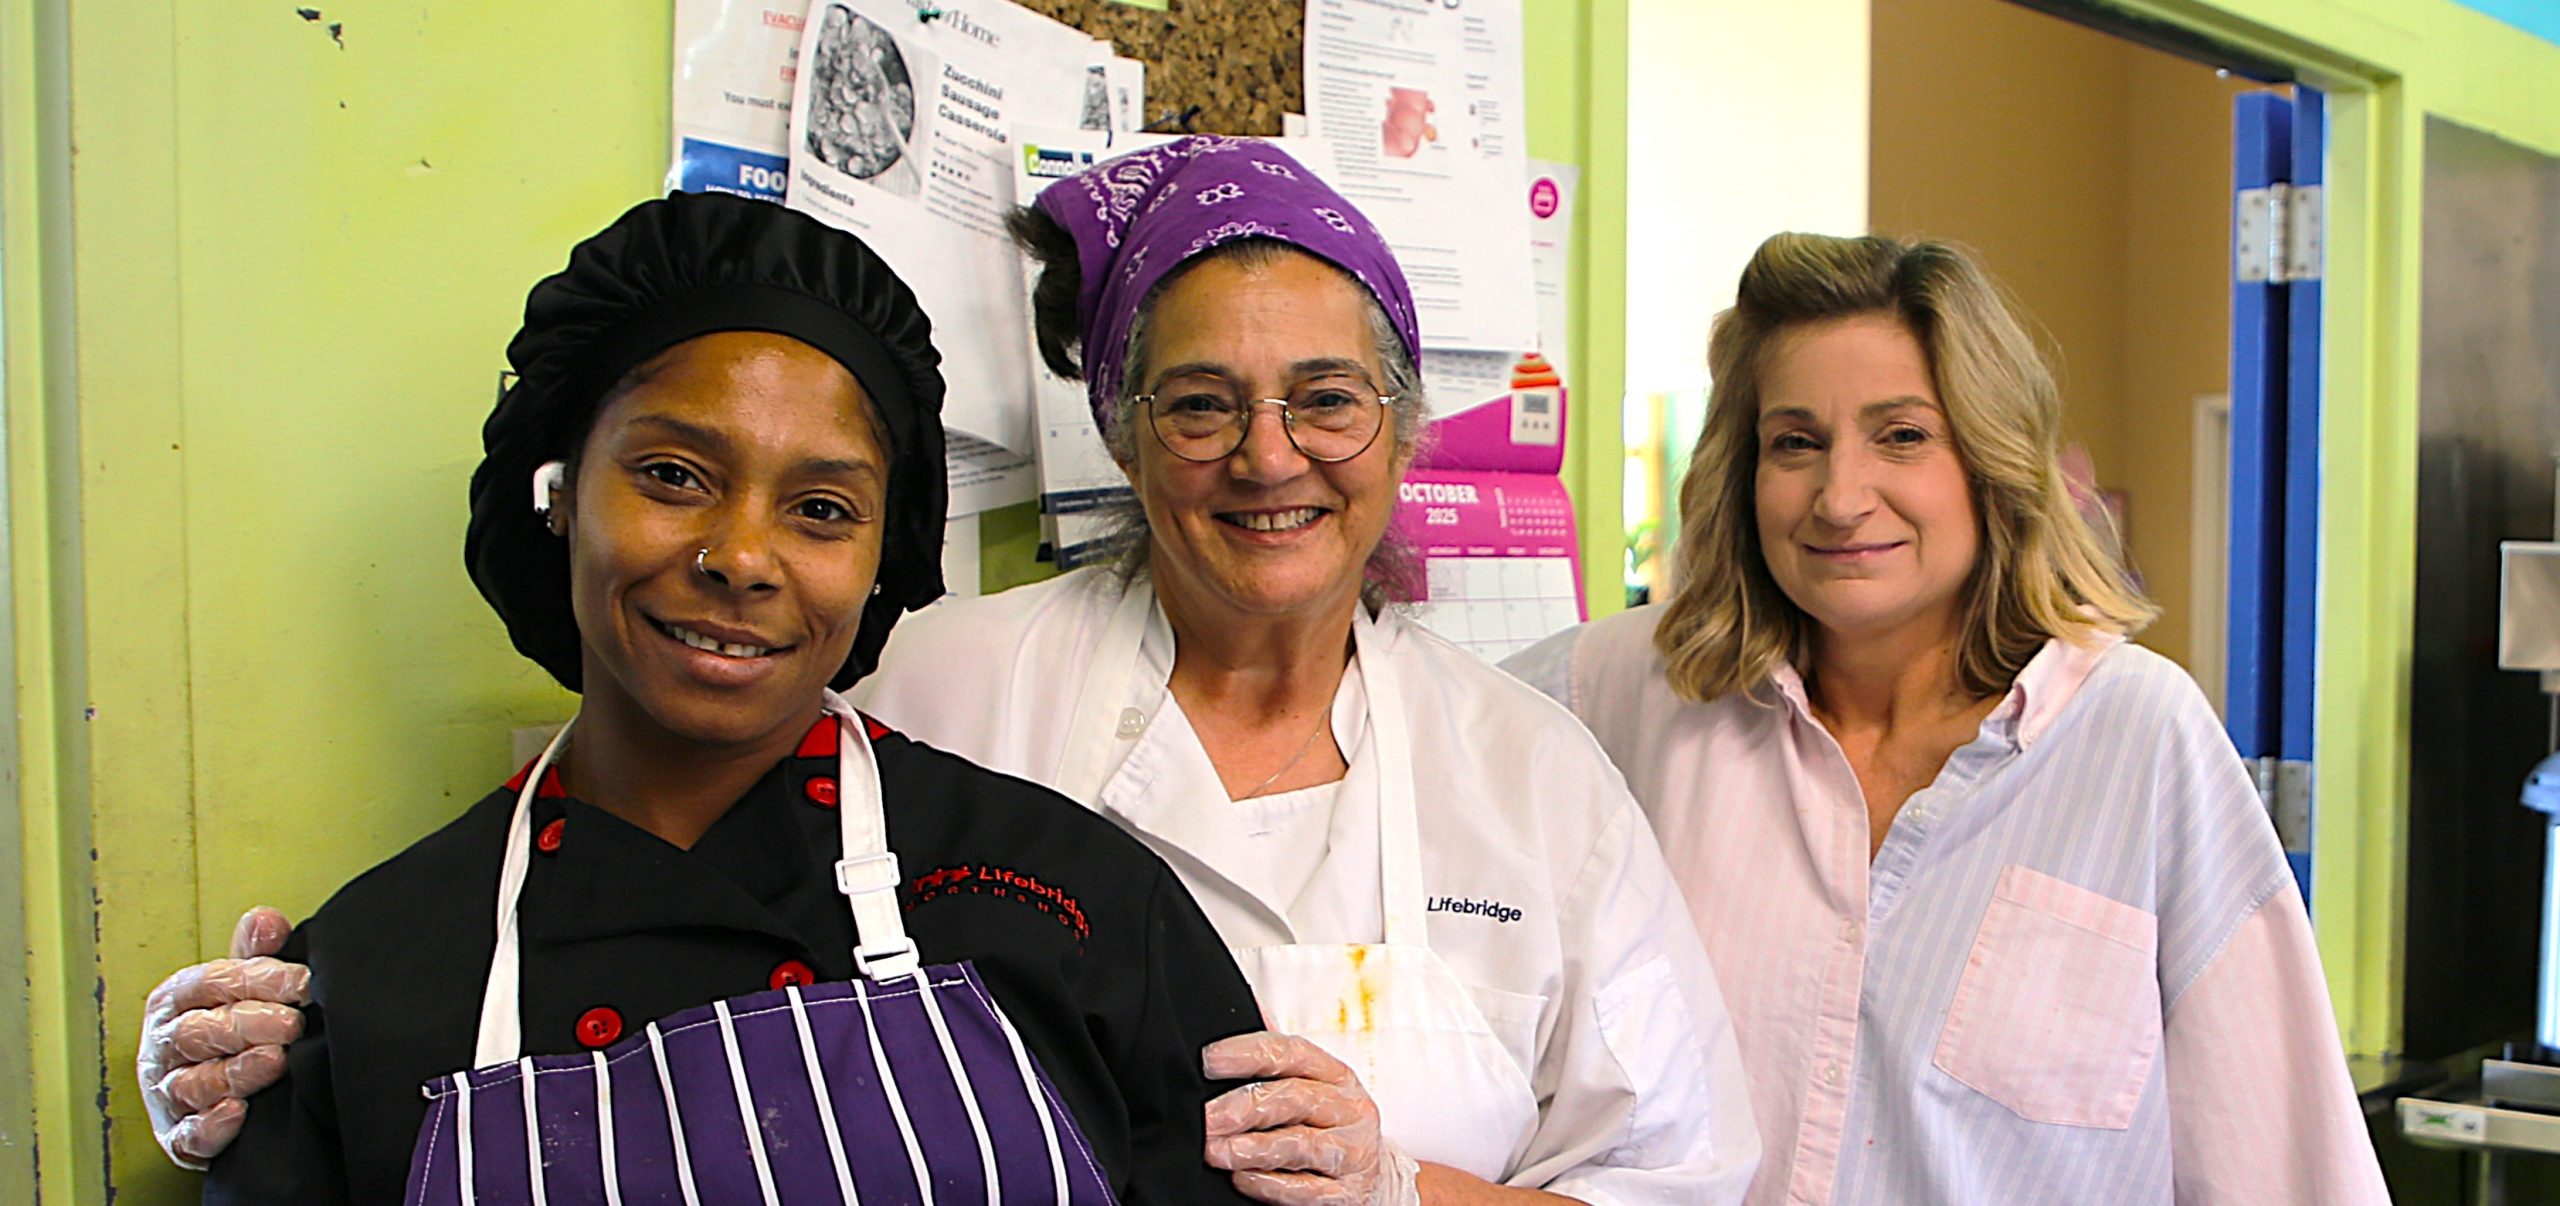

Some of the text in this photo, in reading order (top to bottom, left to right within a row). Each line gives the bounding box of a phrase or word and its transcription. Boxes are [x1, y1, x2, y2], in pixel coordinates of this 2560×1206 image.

[943, 63, 1003, 100] Zucchini
[724, 91, 745, 105] You
[747, 97, 775, 109] must
[941, 84, 1000, 120] Sausage
[938, 104, 1006, 143] Casserole
[800, 169, 856, 206] Ingredients
[1399, 482, 1480, 504] OCTOBER
[1425, 507, 1459, 525] 2025
[1427, 896, 1523, 923] Lifebridge
